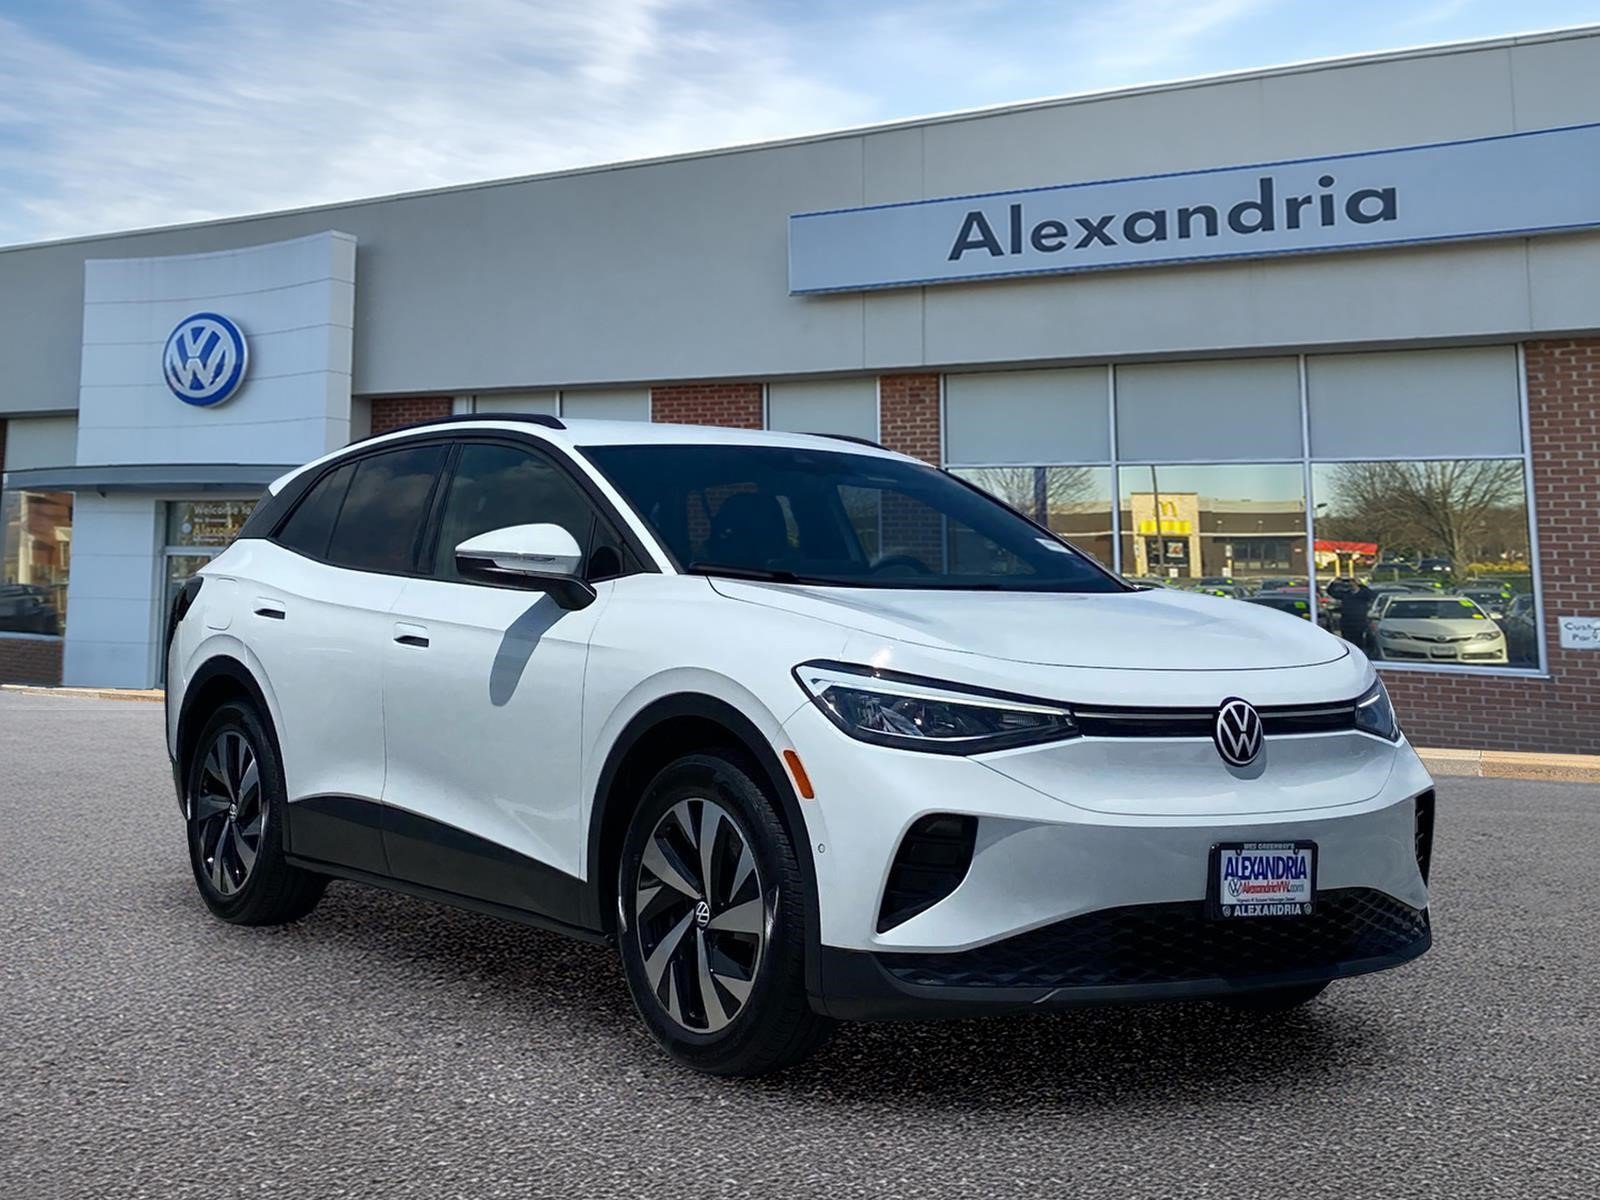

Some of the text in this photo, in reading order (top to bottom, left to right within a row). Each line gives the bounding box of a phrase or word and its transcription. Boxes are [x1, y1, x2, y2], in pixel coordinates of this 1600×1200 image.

[948, 175, 1398, 262] Alexandria
[1224, 855, 1307, 880] ALEXANDRIA
[1234, 904, 1302, 917] ALEXANDRIA
